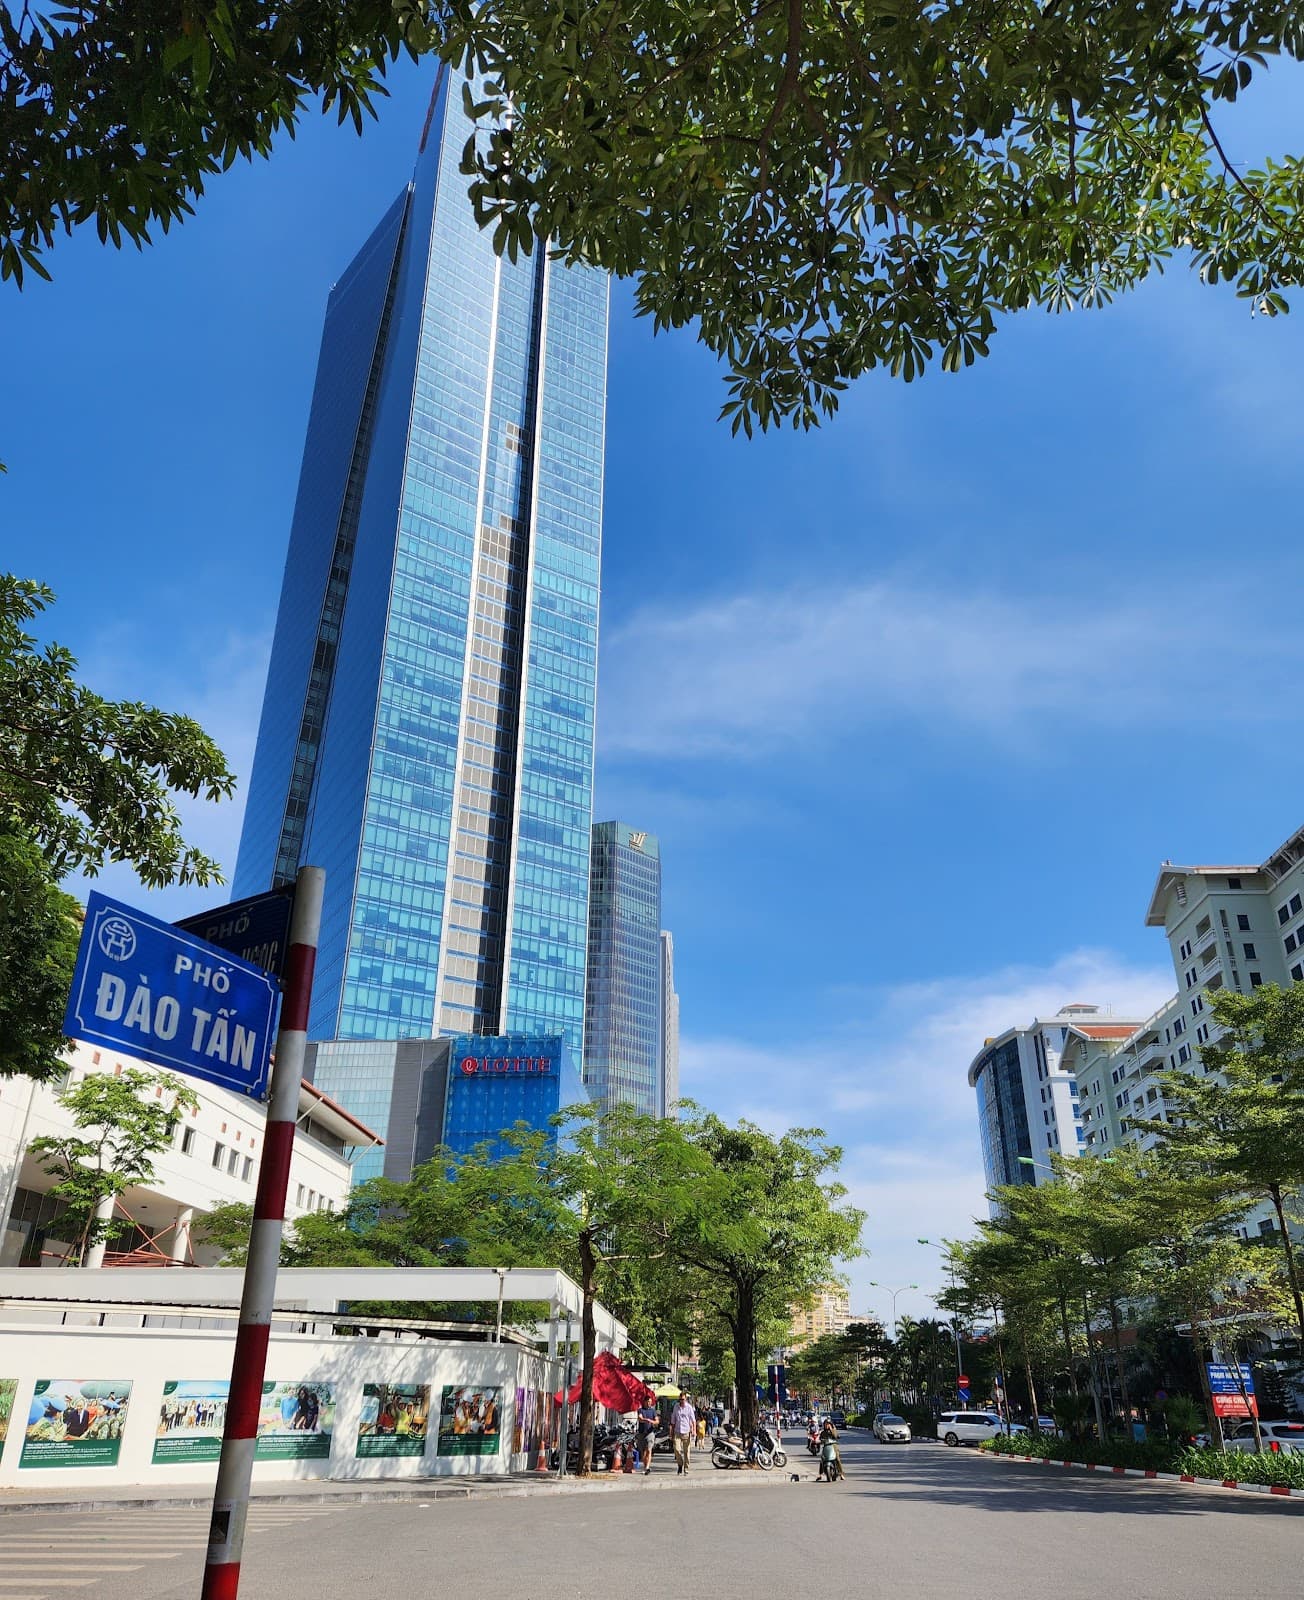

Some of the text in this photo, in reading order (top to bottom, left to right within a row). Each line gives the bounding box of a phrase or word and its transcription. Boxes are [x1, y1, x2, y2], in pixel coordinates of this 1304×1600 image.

[174, 954, 235, 994] PHỐ
[94, 972, 257, 1071] ĐÀO TẤN
[481, 1057, 551, 1073] LOTTE
